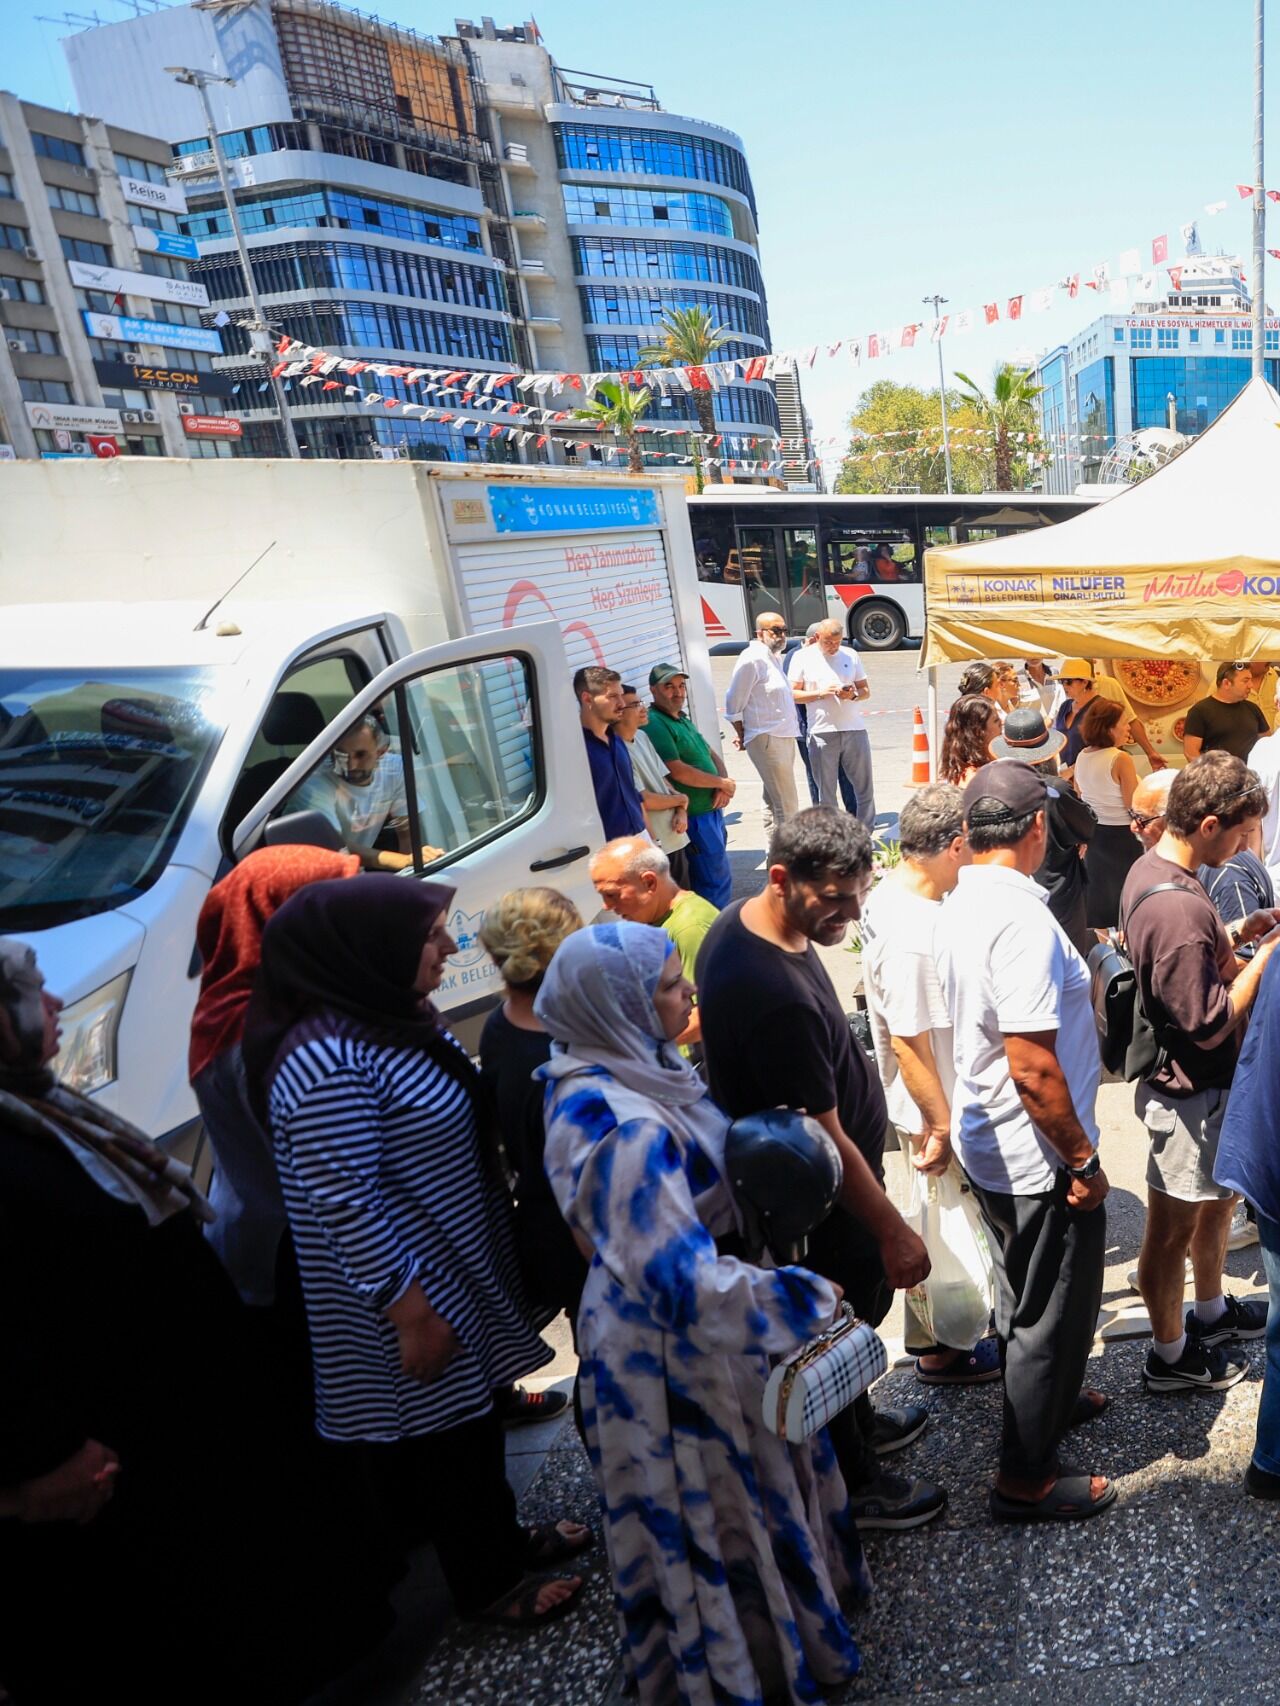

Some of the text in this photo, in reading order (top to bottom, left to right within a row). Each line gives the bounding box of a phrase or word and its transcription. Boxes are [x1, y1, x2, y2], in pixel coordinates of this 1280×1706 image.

[1167, 320, 1194, 328] SOSYAL
[538, 504, 575, 517] KONAK
[564, 547, 592, 576] Hep
[984, 579, 1037, 592] KONAK
[1144, 570, 1218, 601] Mutlu
[591, 586, 615, 614] Hep
[1093, 591, 1126, 600] MUTLU
[461, 963, 497, 985] BELED
